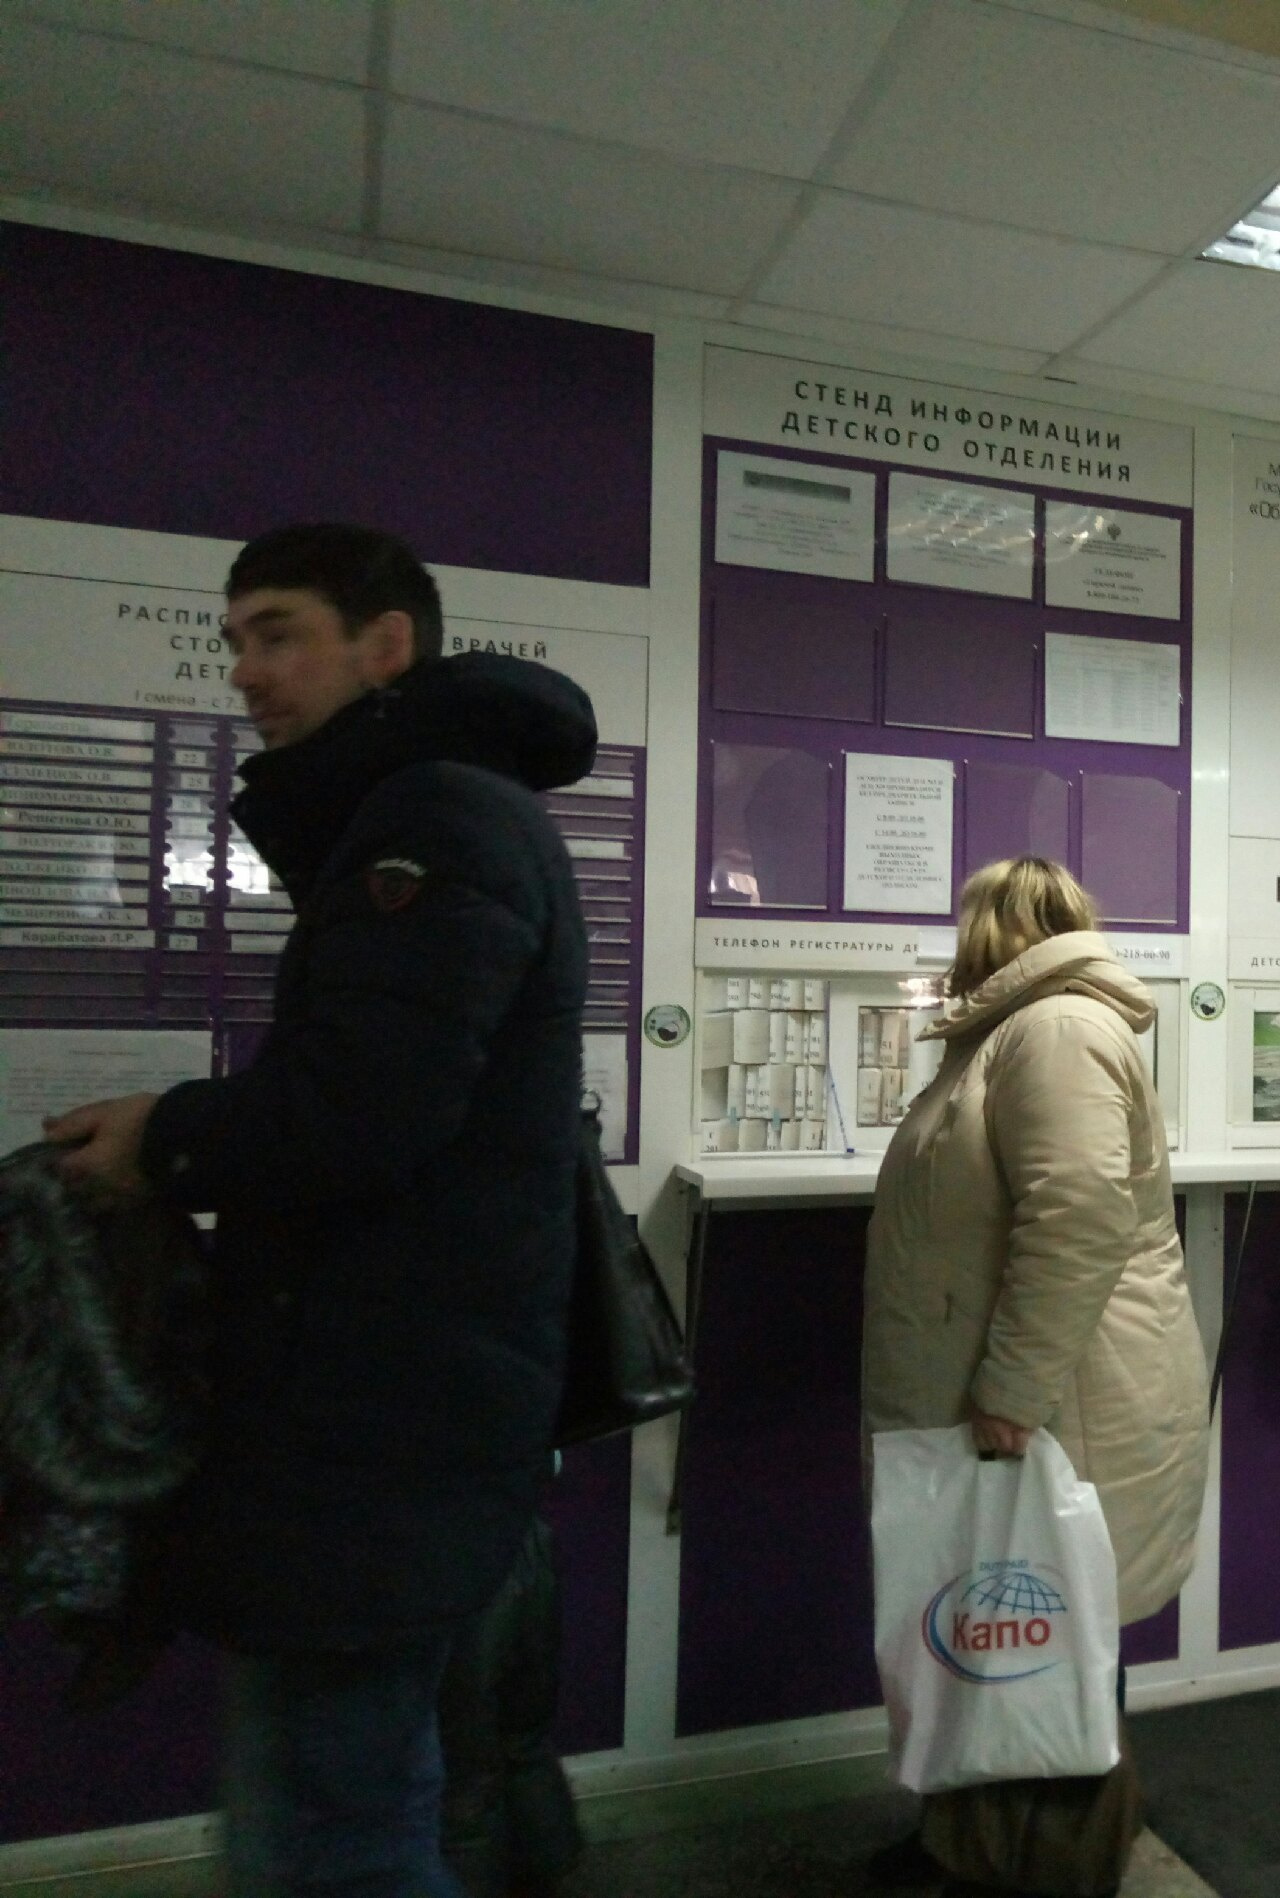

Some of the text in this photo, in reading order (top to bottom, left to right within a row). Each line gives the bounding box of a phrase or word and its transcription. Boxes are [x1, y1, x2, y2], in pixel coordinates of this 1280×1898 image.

[782, 410, 1132, 482] ДЕТСКОГО ОТДЕЛЕНИЯ
[794, 379, 1122, 451] СТЕНД ИНФОРМАЦИИ
[118, 603, 547, 659] РАСПИС ВРАЧЕЙ
[714, 937, 780, 948] ТЕЛЕФОН
[790, 940, 894, 951] РЕГИСТРАТУРЫ
